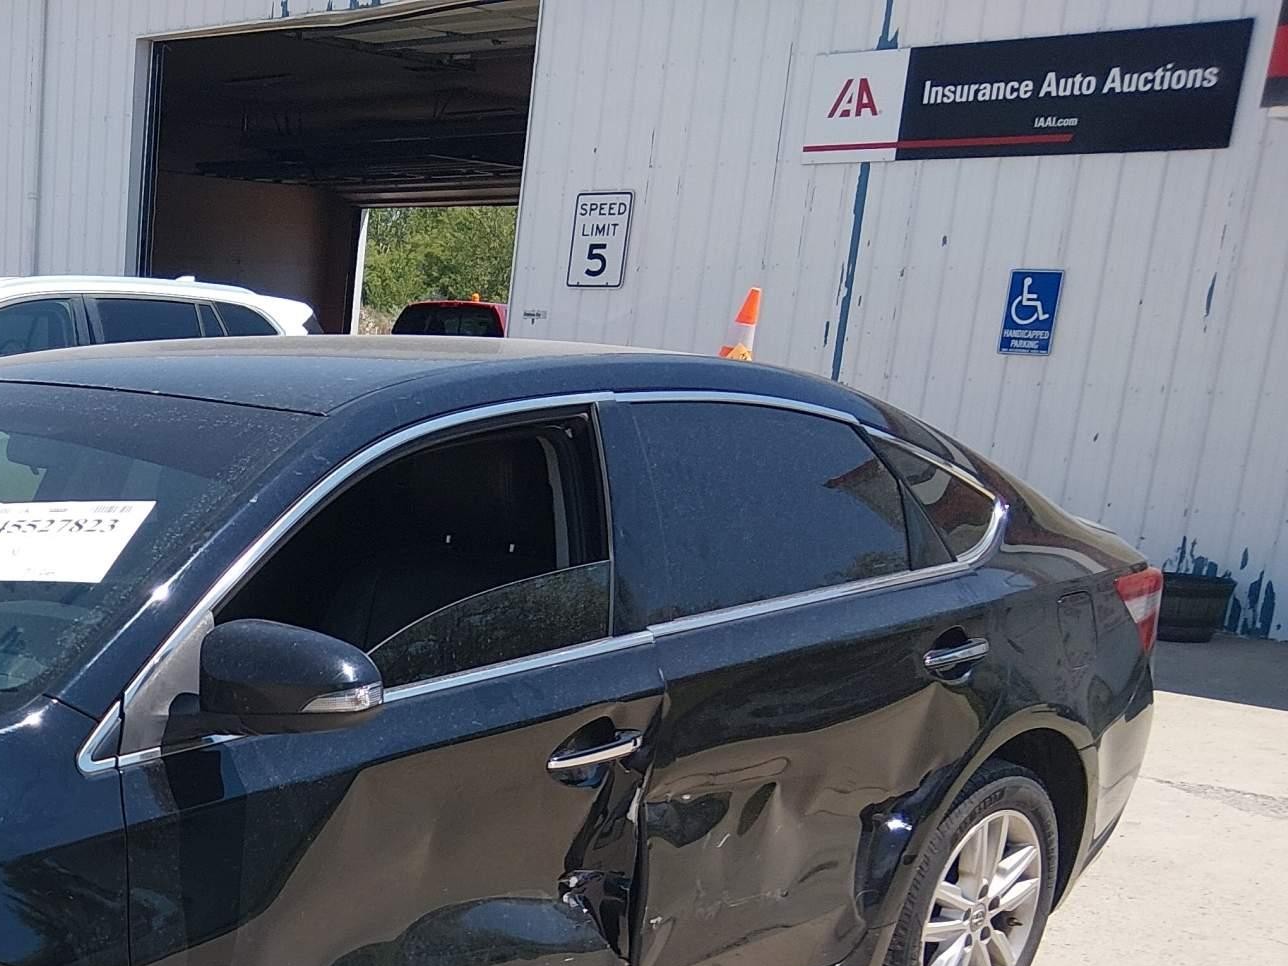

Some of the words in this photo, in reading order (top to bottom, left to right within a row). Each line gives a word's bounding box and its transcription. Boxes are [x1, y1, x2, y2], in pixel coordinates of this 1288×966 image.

[922, 80, 1034, 104] Insurance
[1039, 71, 1097, 97] Auto
[1102, 62, 1221, 94] Auctions
[1034, 116, 1079, 128] IAAI.com
[579, 202, 627, 217] SPEED
[581, 223, 620, 237] LIMIT
[584, 243, 608, 277] 5
[1003, 329, 1050, 340] HANDICAPPED
[1009, 339, 1040, 349] PARKING
